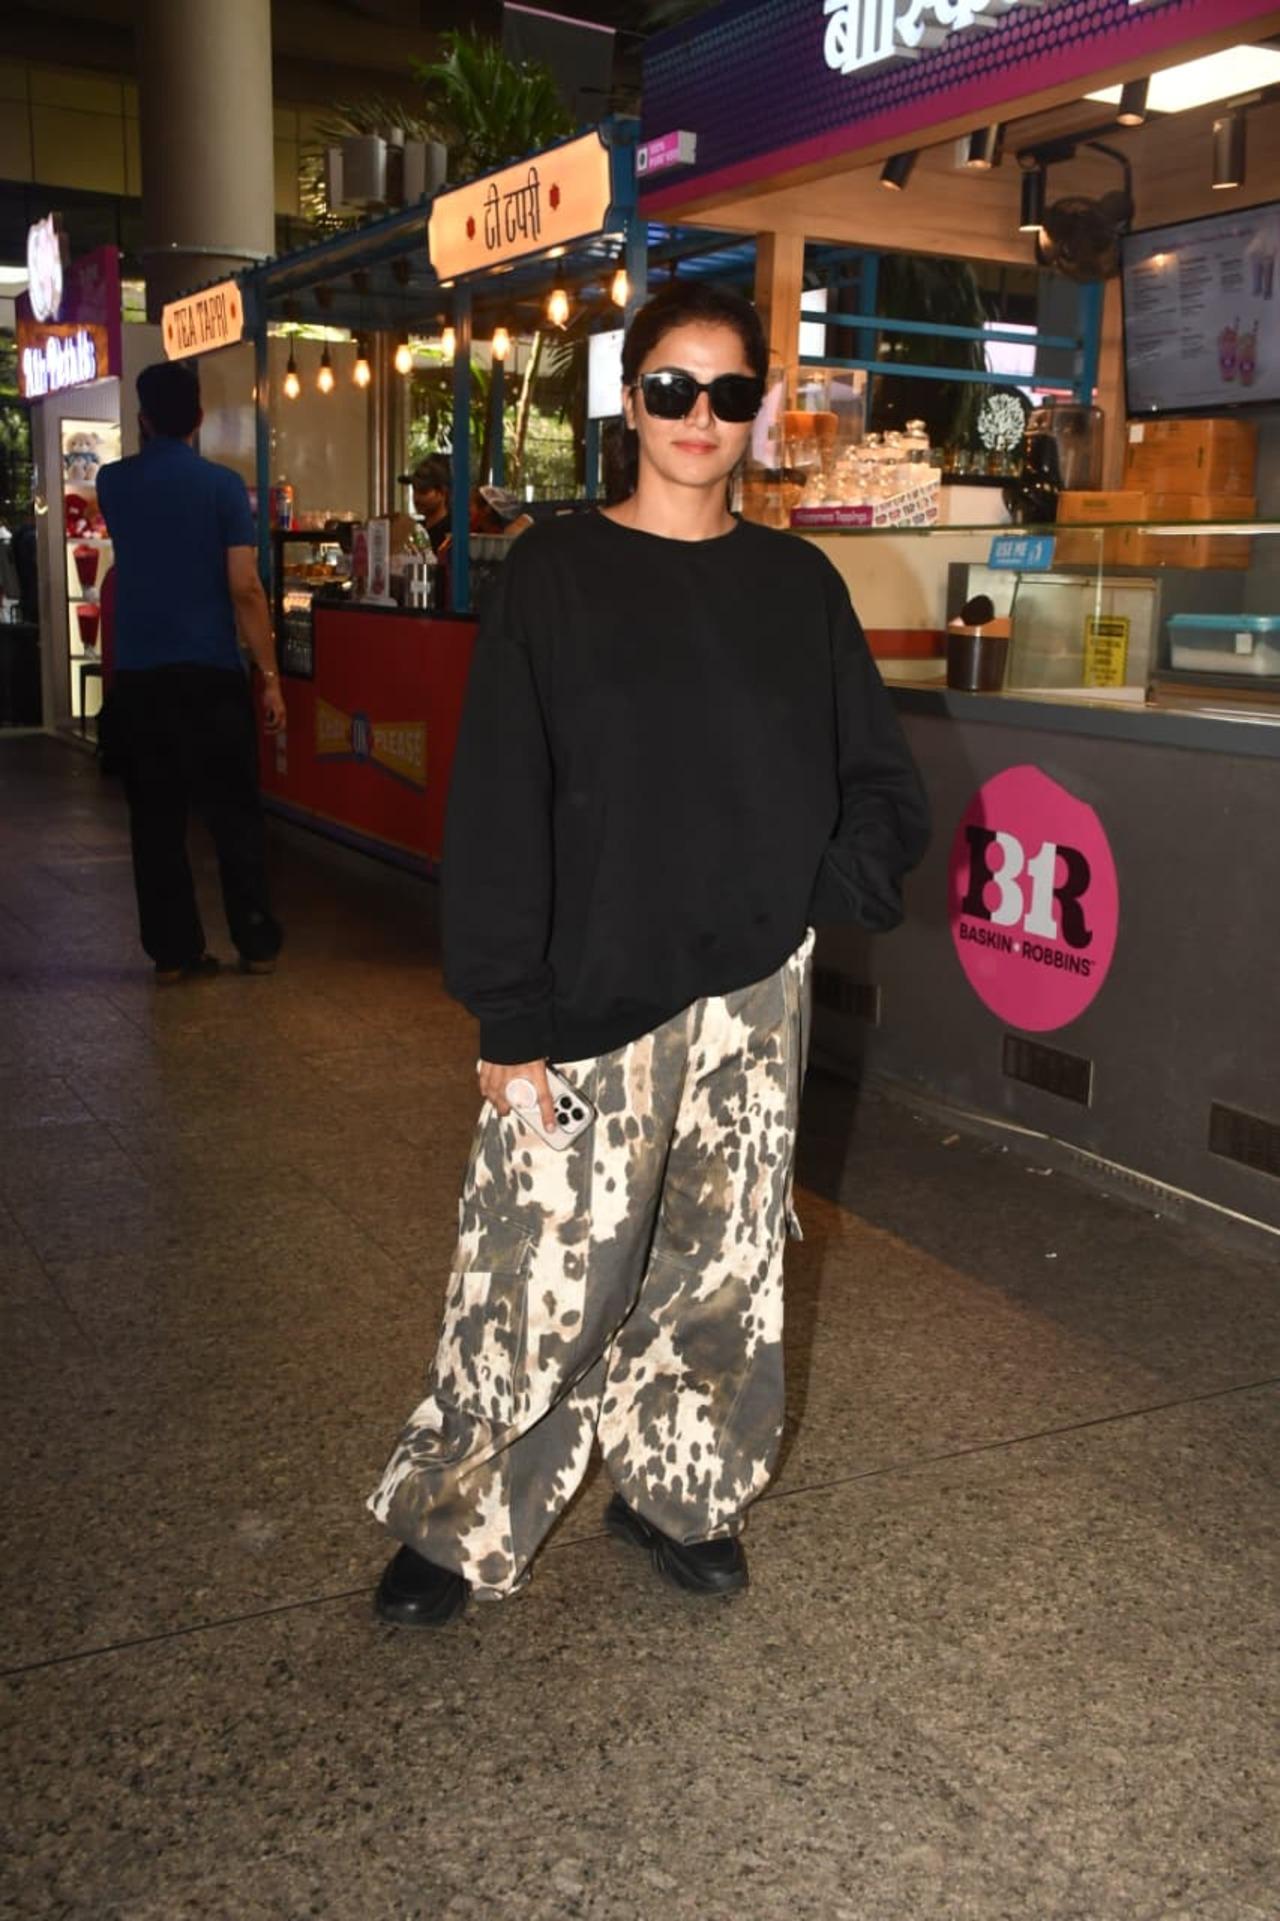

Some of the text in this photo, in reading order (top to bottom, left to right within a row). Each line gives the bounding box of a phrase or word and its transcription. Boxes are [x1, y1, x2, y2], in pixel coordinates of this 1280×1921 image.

[483, 166, 541, 250] टी टपरी
[173, 292, 228, 350] TEA TAPRI
